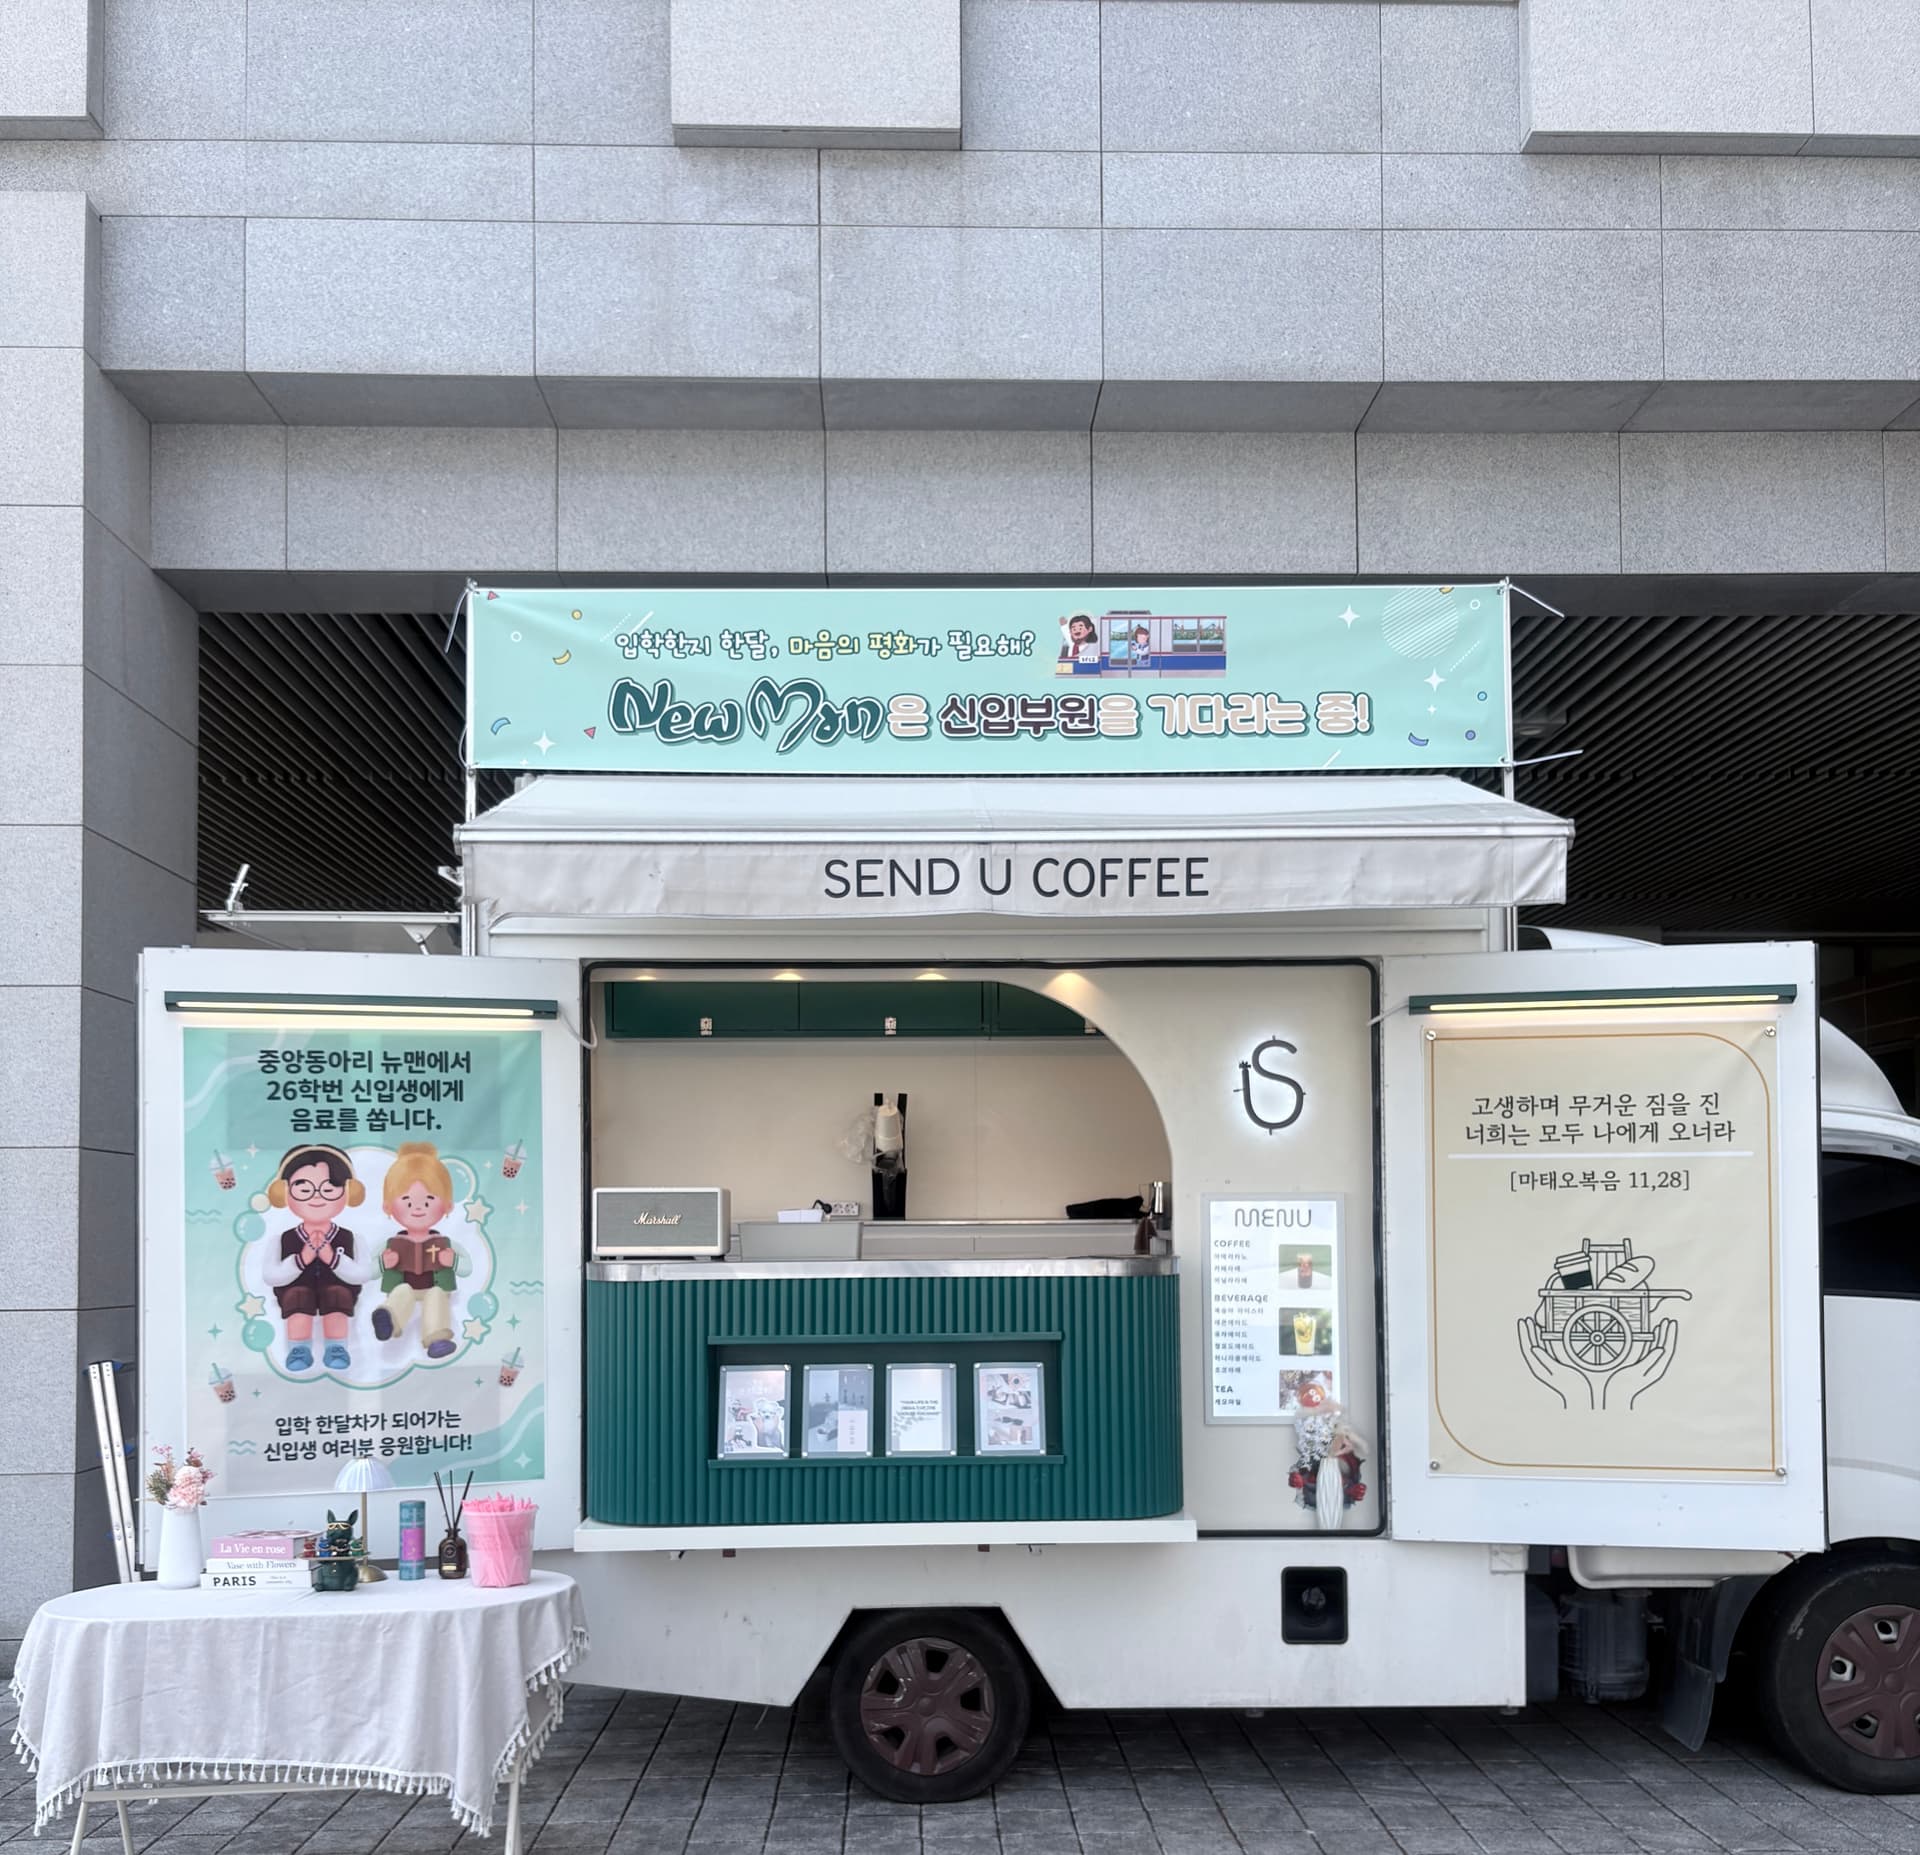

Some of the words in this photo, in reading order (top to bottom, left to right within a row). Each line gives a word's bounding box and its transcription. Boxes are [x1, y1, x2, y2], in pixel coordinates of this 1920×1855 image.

[615, 628, 712, 660] 입학한지
[719, 628, 779, 661] 한달,
[788, 629, 861, 661] 마음의
[867, 630, 942, 659] 평화가
[947, 629, 1036, 662] 필요해?
[936, 693, 1142, 740] 신입부원을
[1146, 692, 1309, 738] 기다리는
[1314, 691, 1374, 737] 중!
[824, 858, 960, 899] SEND
[979, 857, 1012, 896] U
[1032, 856, 1210, 898] COFFEE
[257, 1049, 374, 1075] 중앙동아리
[380, 1049, 472, 1075] 뉴맨에서
[266, 1079, 344, 1103] 26학번
[350, 1079, 465, 1103] 신입생에게
[1471, 1094, 1560, 1119] 고생하며
[1568, 1094, 1638, 1117] 무거운
[1646, 1092, 1691, 1118] 짐을
[1699, 1091, 1721, 1116] 진
[290, 1108, 359, 1133] 음료를
[366, 1107, 442, 1133] 쏩니다.
[1465, 1123, 1531, 1146] 너희는
[1538, 1123, 1585, 1145] 모두
[1593, 1122, 1660, 1144] 나에게
[1668, 1120, 1736, 1143] 오너라
[1510, 1170, 1621, 1192] [마태오복음
[1628, 1169, 1690, 1192] 11,28]
[633, 1211, 681, 1225] Marshall
[1234, 1208, 1312, 1228] MENU
[1214, 1240, 1251, 1248] COFFEE
[1214, 1385, 1234, 1394] TEA
[275, 1416, 312, 1436] 입학
[315, 1412, 388, 1435] 한달차가
[391, 1409, 462, 1431] 되어가는
[263, 1439, 317, 1462] 신입생
[322, 1437, 376, 1459] 여러분
[379, 1433, 473, 1457] 응원합니다!
[220, 1543, 232, 1553] La
[234, 1543, 250, 1553] Vie
[252, 1545, 263, 1554] en
[265, 1545, 286, 1554] rose
[226, 1561, 243, 1570] Vase
[246, 1560, 264, 1569] with
[266, 1560, 297, 1569] Flowers
[213, 1575, 257, 1587] PARIS
